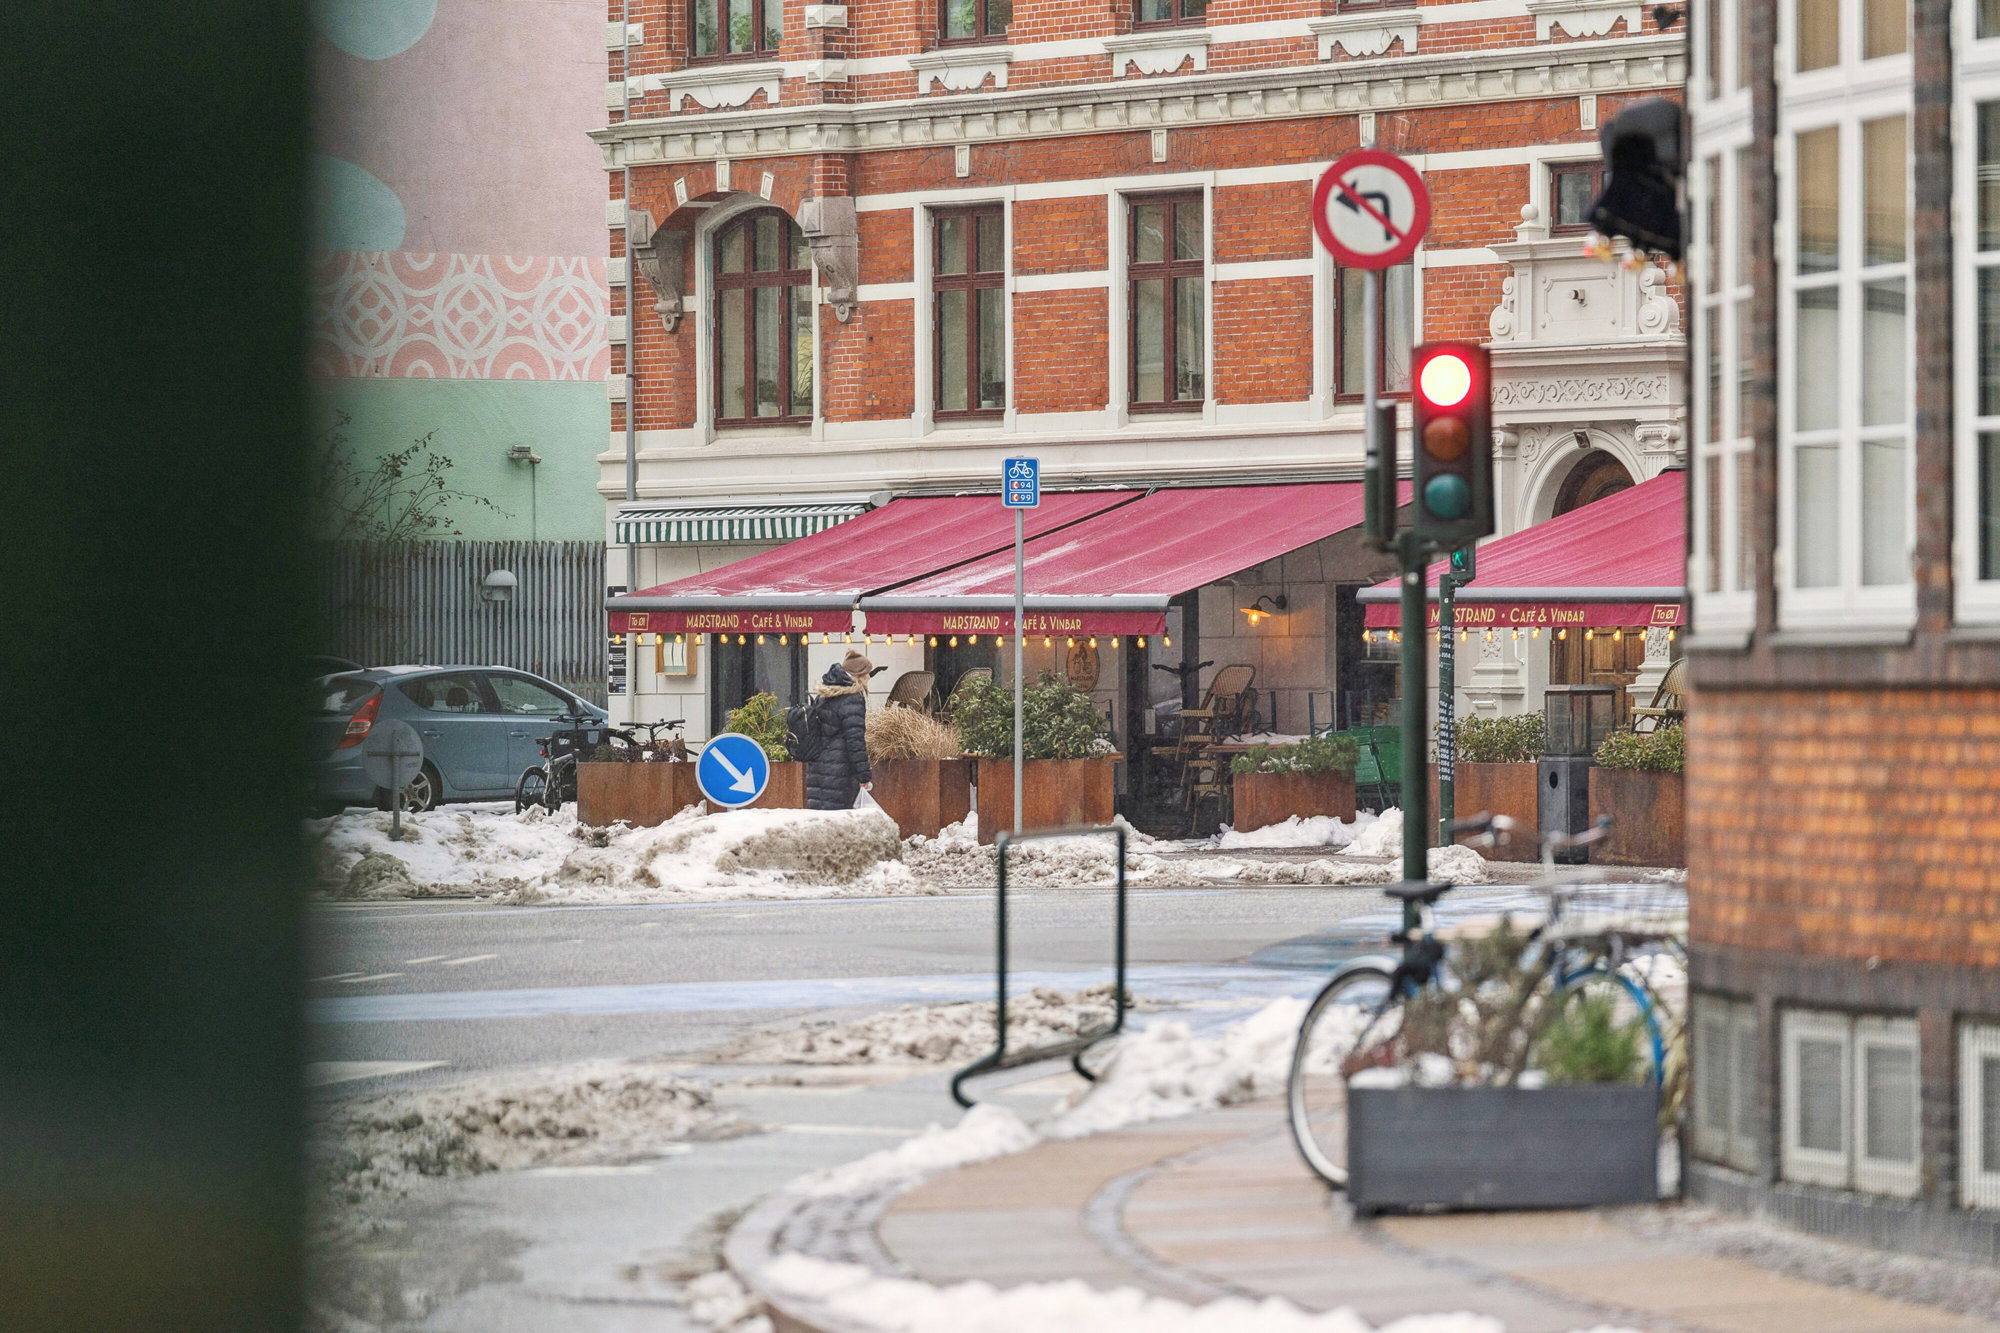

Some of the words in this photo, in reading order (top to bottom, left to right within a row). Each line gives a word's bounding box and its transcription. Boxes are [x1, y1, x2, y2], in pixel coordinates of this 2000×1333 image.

[686, 614, 739, 628] MARSTRAND
[775, 614, 782, 628] &
[1430, 607, 1496, 623] MSTRAND
[1537, 608, 1547, 623] &
[1656, 609, 1665, 619] To
[943, 616, 1000, 630] MARSTRAND
[1039, 616, 1047, 630] &
